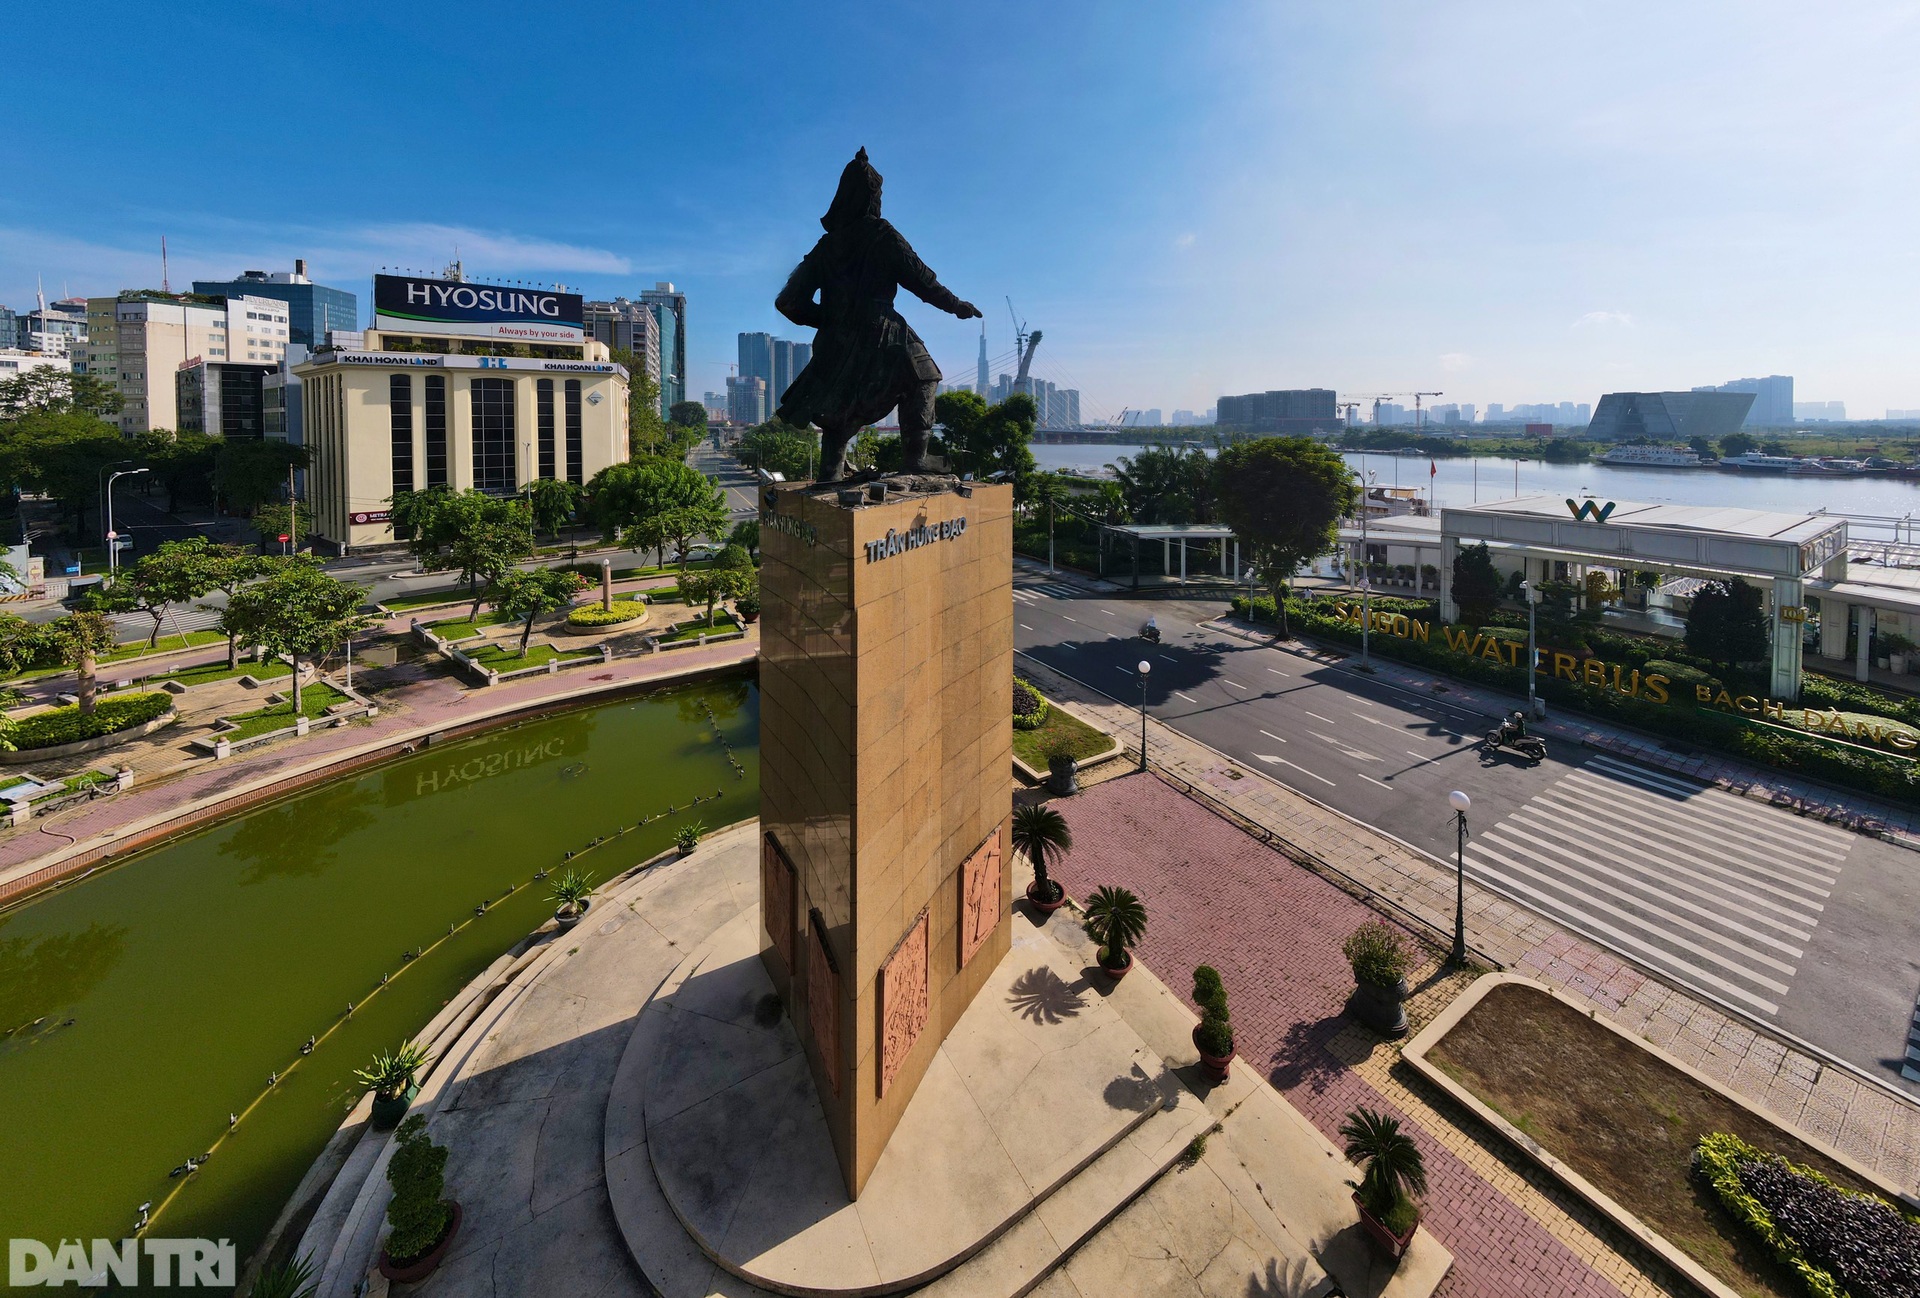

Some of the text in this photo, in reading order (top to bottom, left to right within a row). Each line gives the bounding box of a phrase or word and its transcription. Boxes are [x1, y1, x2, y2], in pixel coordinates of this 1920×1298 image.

[407, 282, 560, 317] HYOSUNG
[498, 326, 528, 337] Always
[529, 329, 540, 338] by
[559, 331, 575, 339] side
[345, 355, 373, 363] KHAI
[375, 356, 408, 365] HOAN
[941, 516, 967, 541] ĐẠO
[1334, 601, 1671, 704] SAIGON WATERBUS
[1696, 684, 1783, 720] BẠCH
